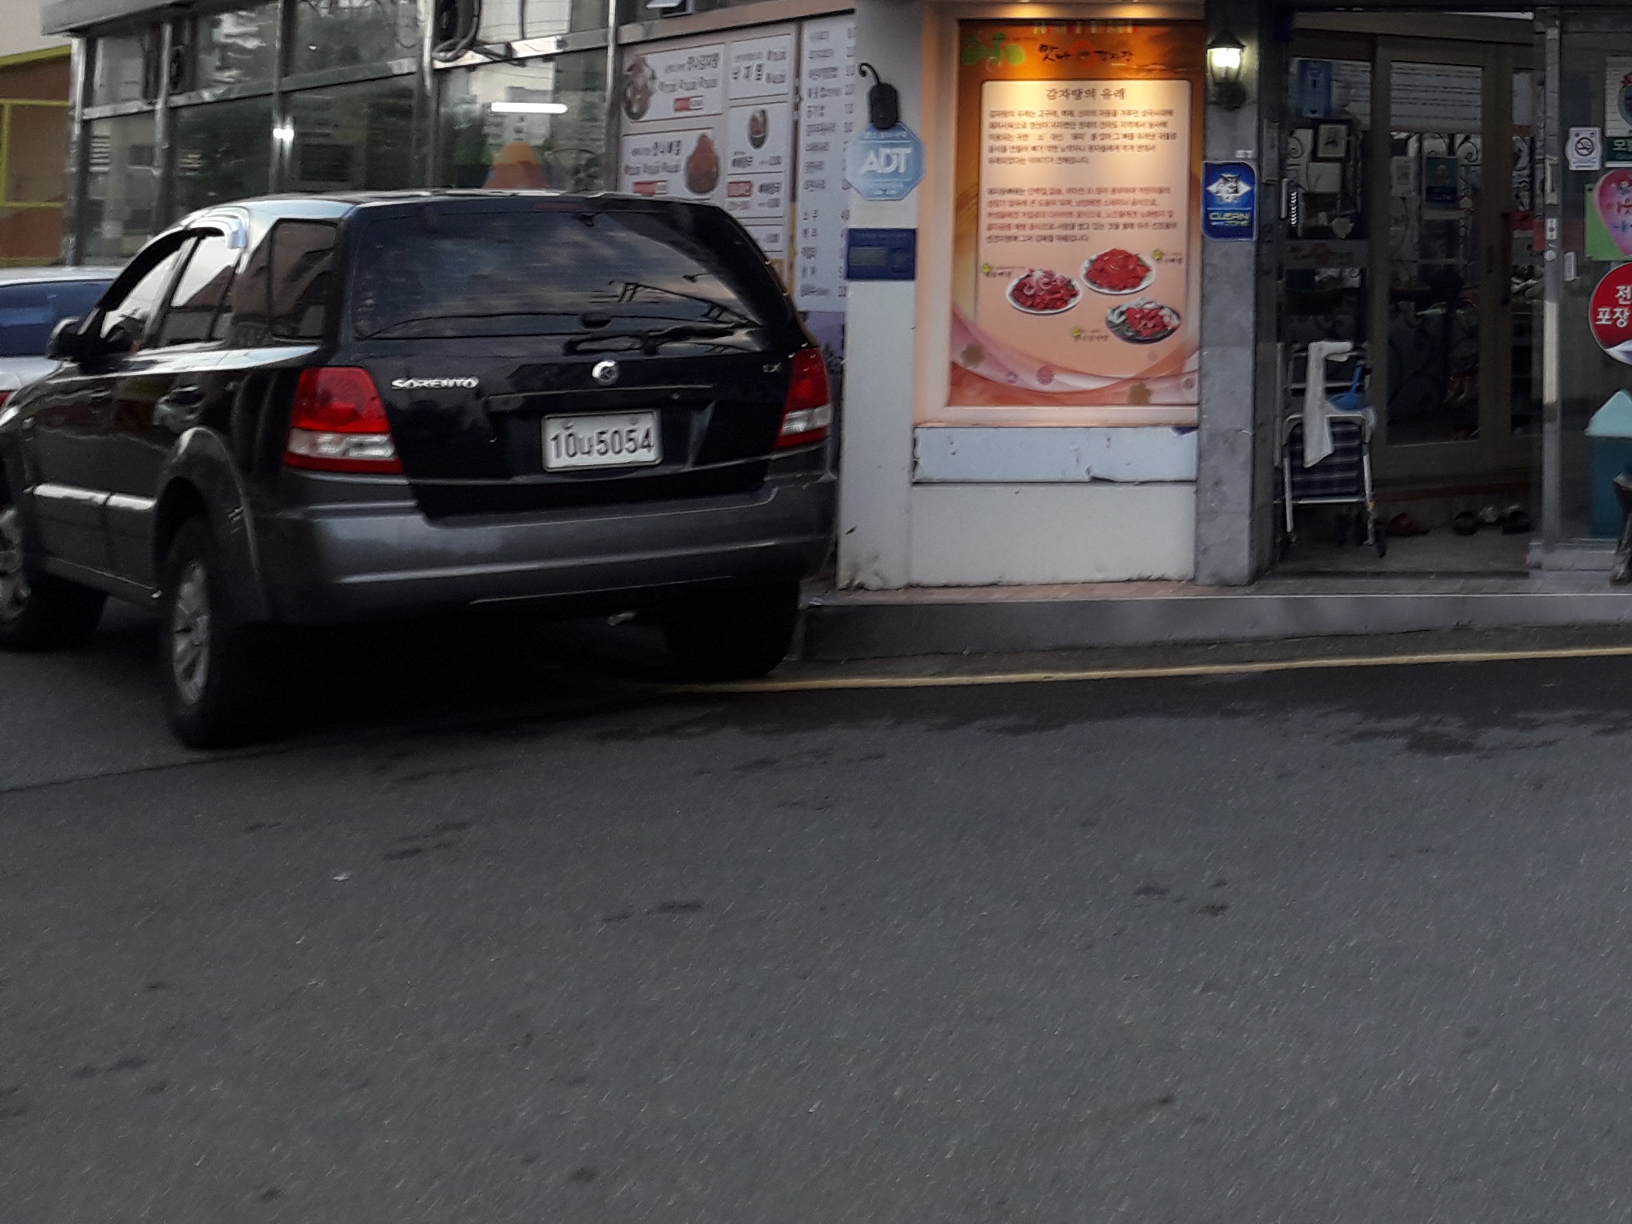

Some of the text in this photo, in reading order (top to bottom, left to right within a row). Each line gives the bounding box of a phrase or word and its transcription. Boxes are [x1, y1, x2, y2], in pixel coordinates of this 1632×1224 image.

[860, 147, 912, 174] ADT
[1595, 307, 1632, 328] 포장
[391, 377, 479, 391] SORENTO
